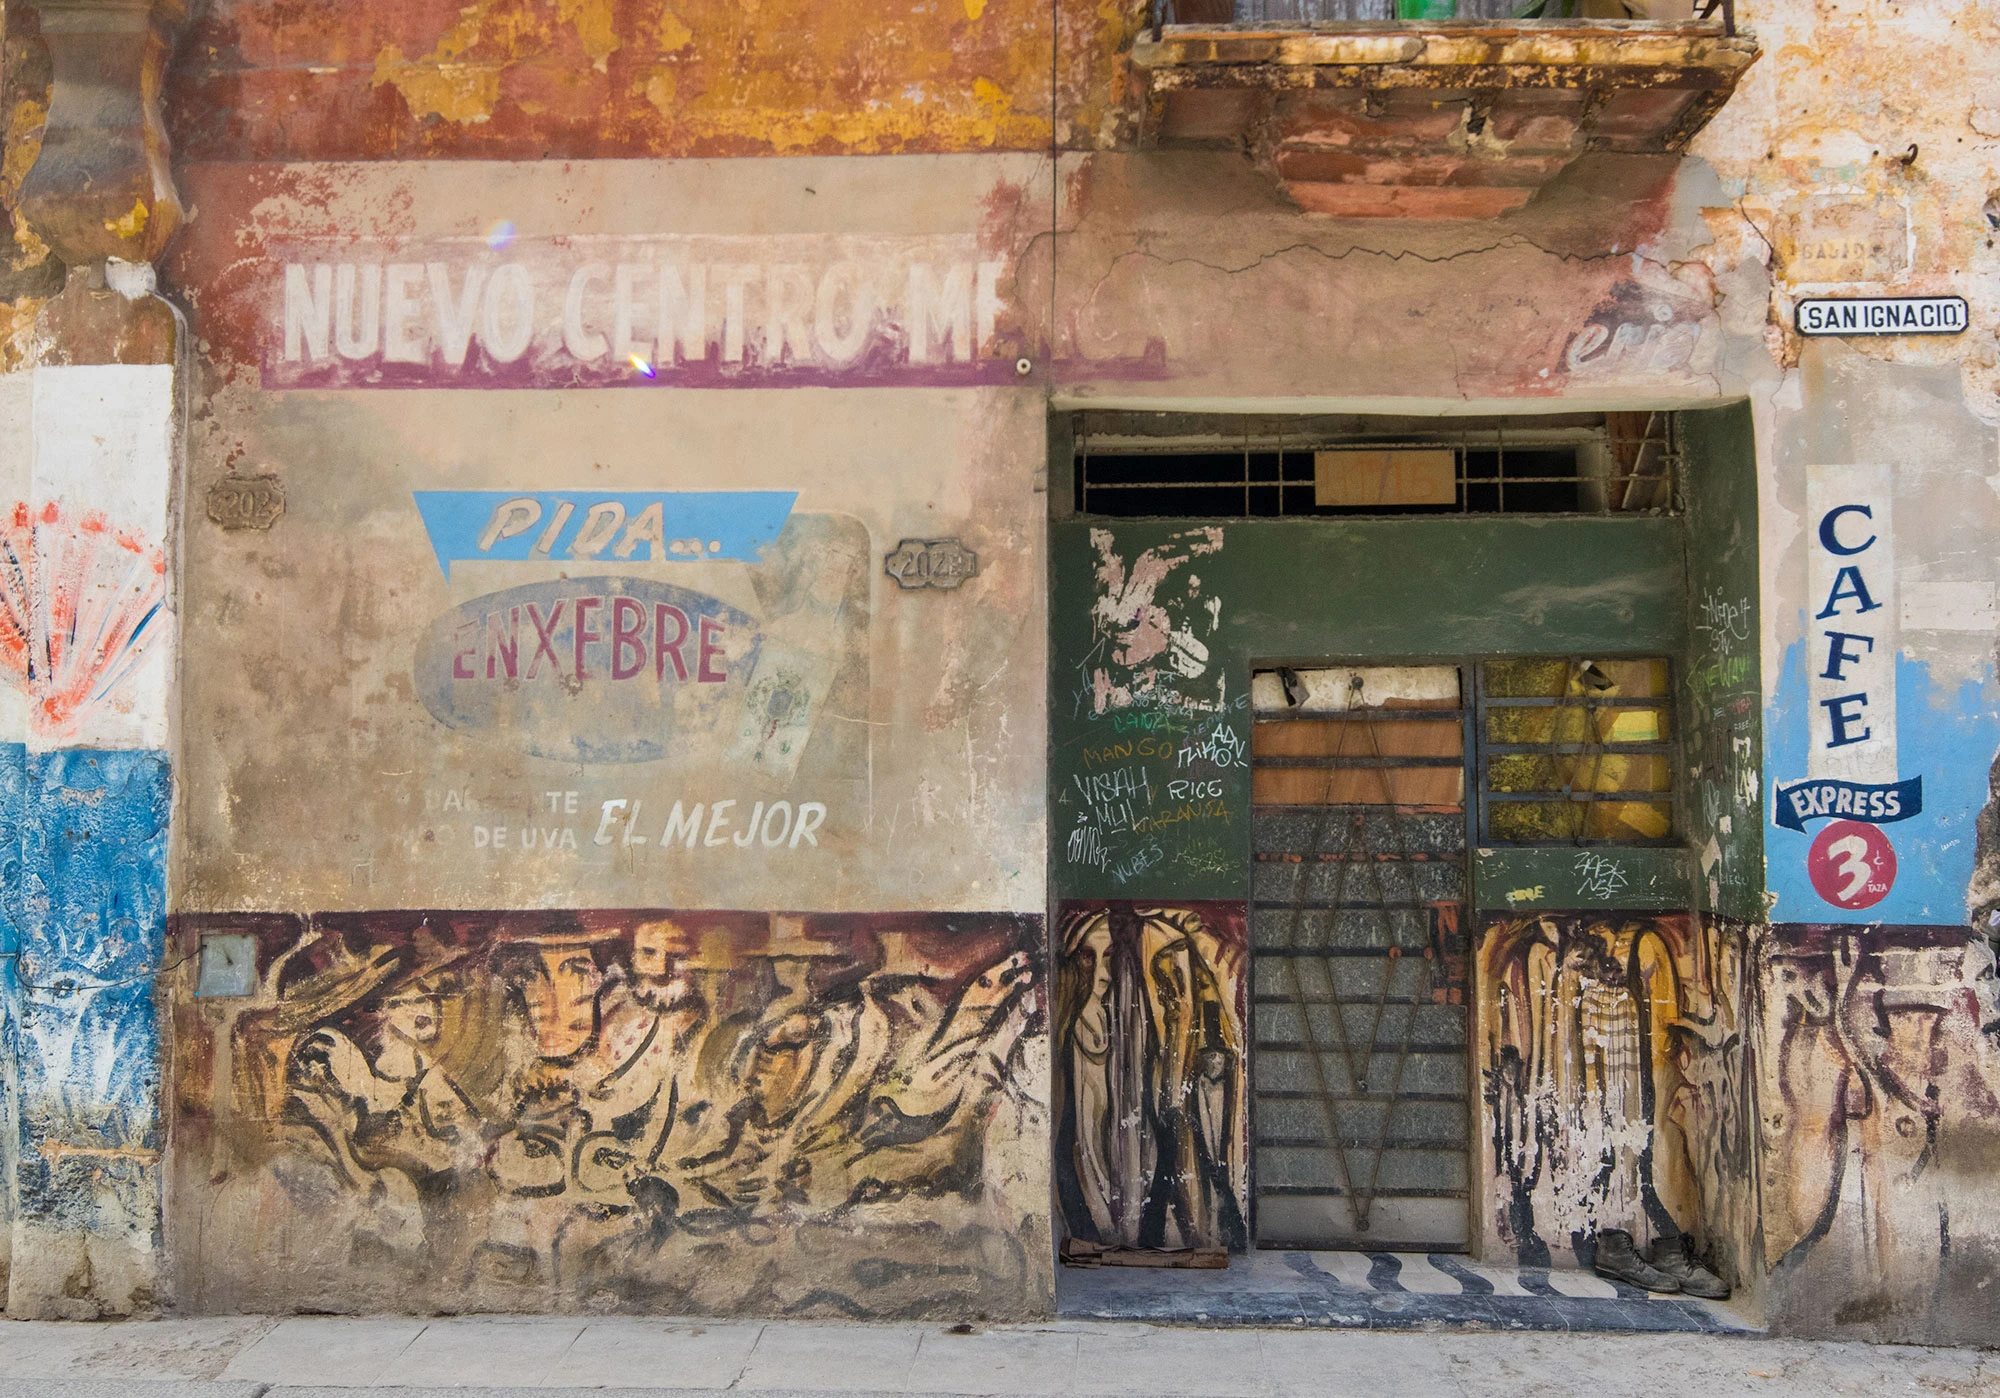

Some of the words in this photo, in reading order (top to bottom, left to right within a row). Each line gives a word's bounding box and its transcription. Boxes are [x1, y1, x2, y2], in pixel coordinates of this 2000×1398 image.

[284, 262, 534, 365] NUEVO
[565, 261, 876, 367] CENTRO
[1808, 306, 1857, 329] SAN
[1864, 304, 1958, 328] IGNACIO
[1815, 503, 1883, 749] CAFE
[1083, 737, 1173, 769] MANGO
[1789, 785, 1901, 818] EXPRESS
[473, 825, 507, 850] DE
[521, 826, 577, 851] UVA
[593, 798, 648, 847] EL
[660, 799, 827, 849] MEJOR
[1828, 834, 1872, 901] 3
